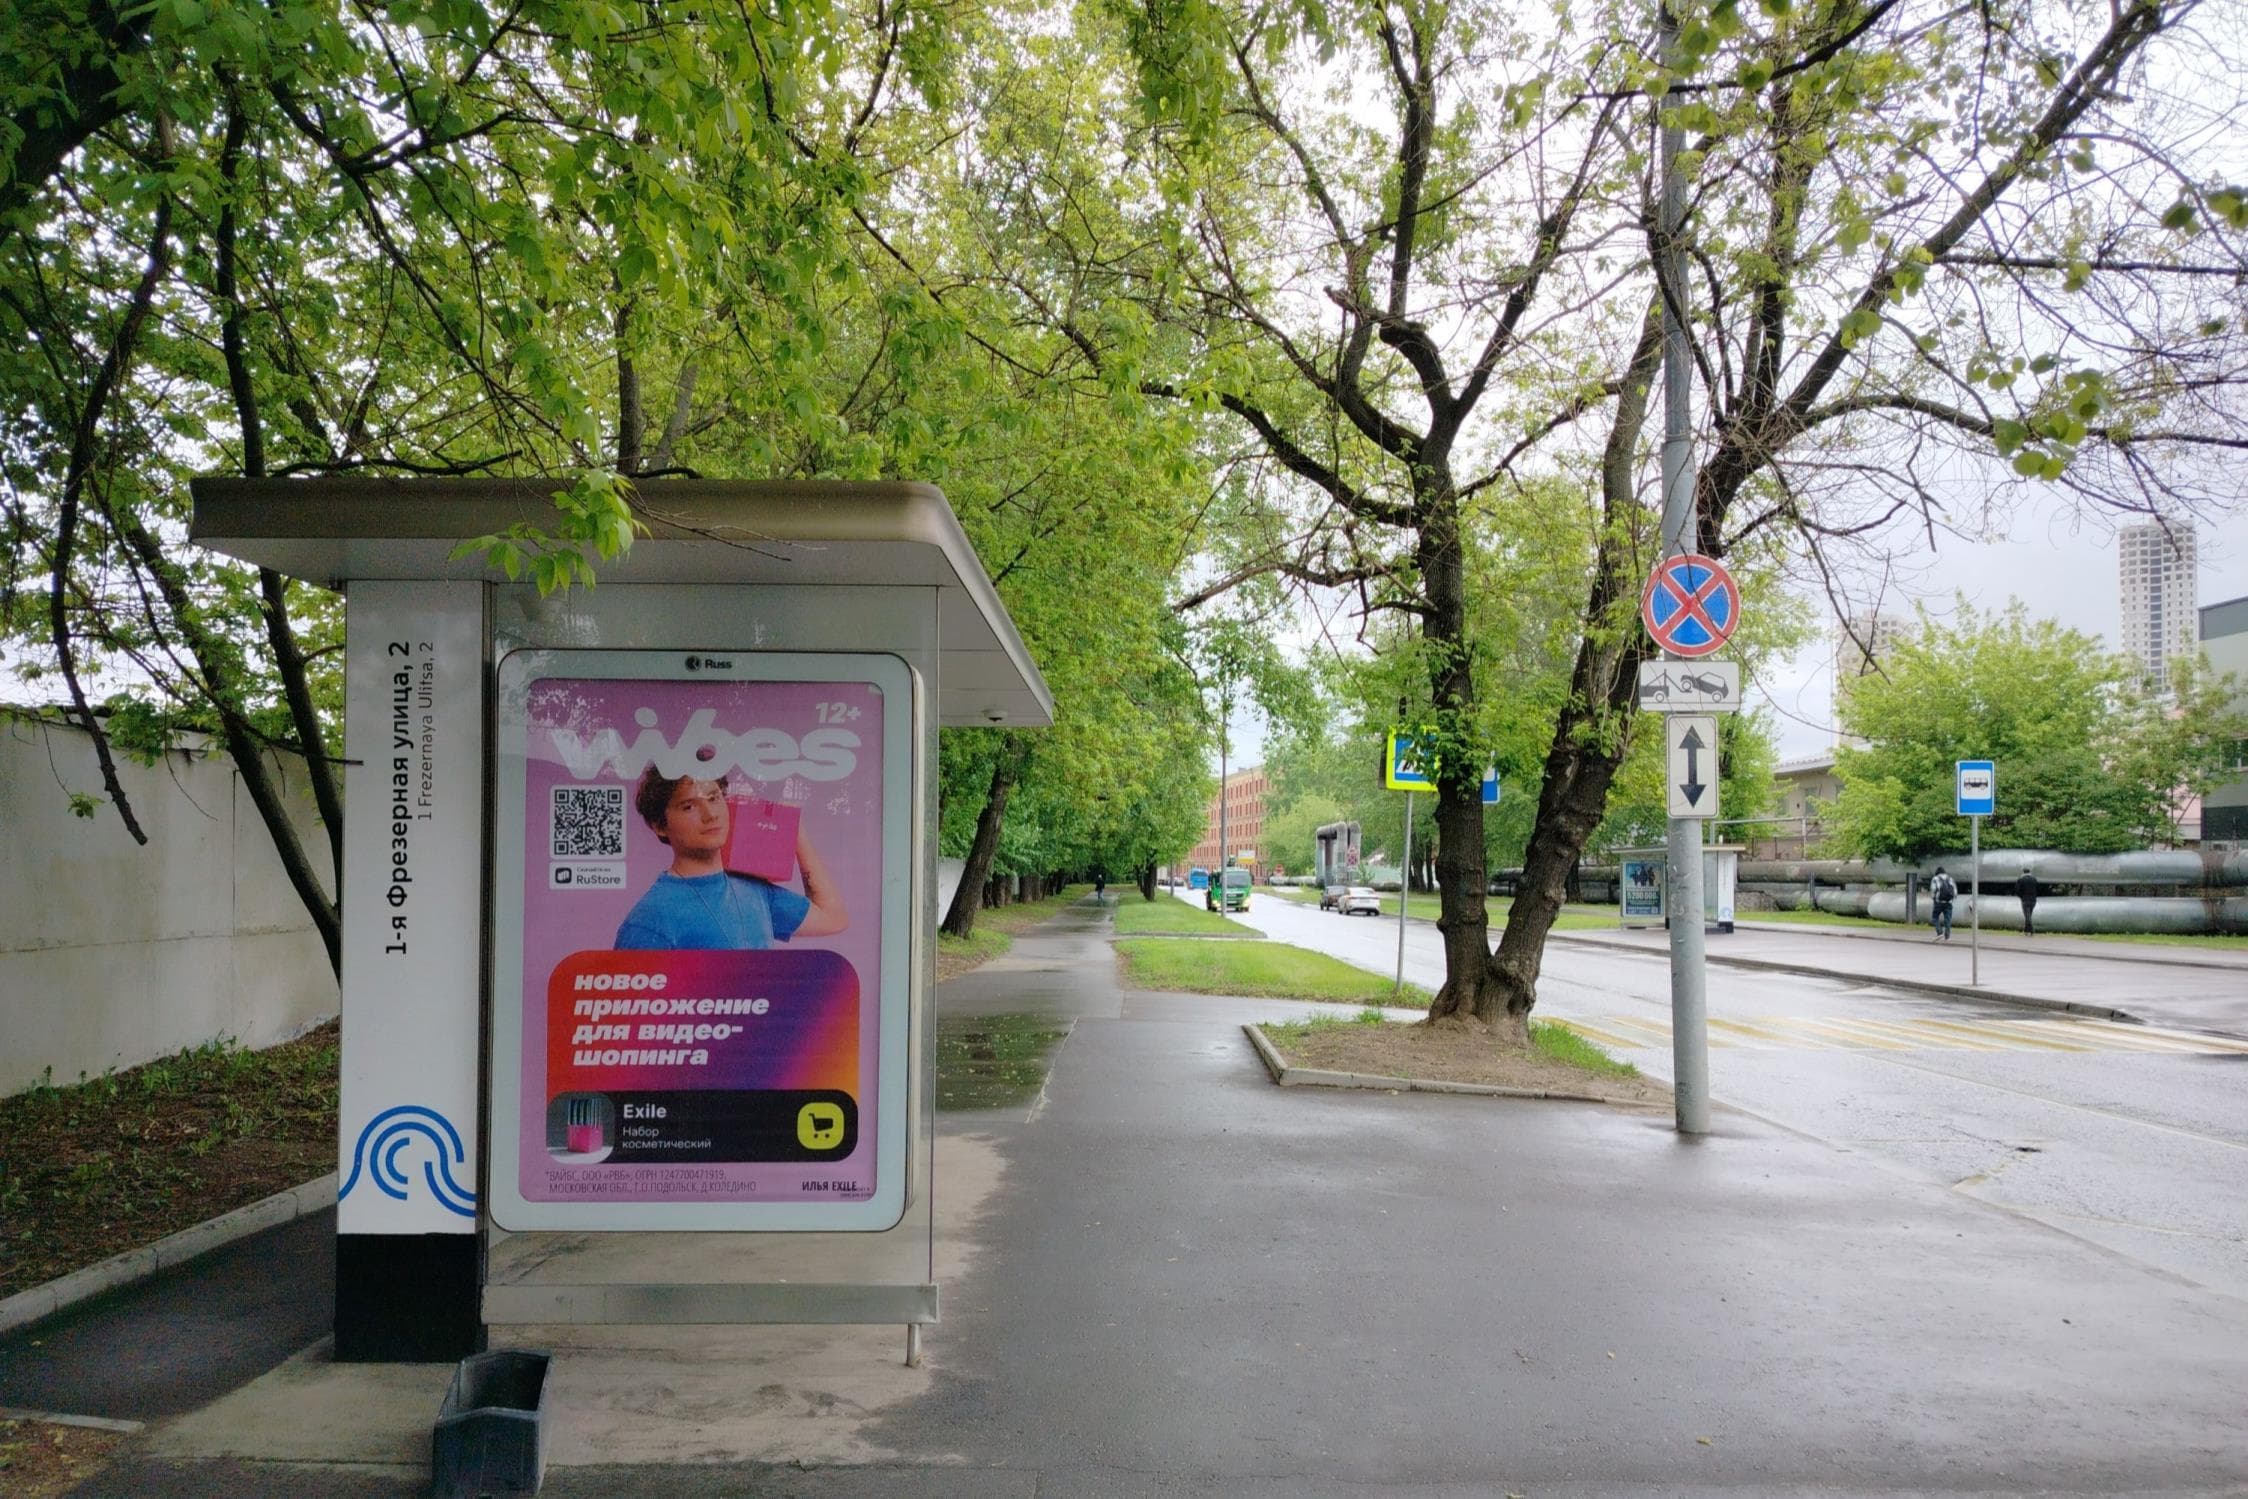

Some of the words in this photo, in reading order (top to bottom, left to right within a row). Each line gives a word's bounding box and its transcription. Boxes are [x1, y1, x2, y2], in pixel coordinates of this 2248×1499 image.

[388, 641, 410, 657] 2
[419, 642, 434, 652] 2
[705, 659, 732, 669] Russ
[418, 658, 435, 708] Ulitsa,
[392, 665, 414, 749] улица,
[815, 702, 862, 724] 12+
[418, 715, 436, 806] Frezernaya
[418, 811, 432, 820] 1
[386, 757, 413, 907] Фрезерная
[576, 875, 621, 885] RuStore
[386, 916, 407, 954] 1-я
[574, 974, 668, 990] новое
[574, 998, 770, 1022] приложение
[572, 1024, 631, 1045] для
[638, 1023, 744, 1044] видео-
[573, 1049, 709, 1066] шопинга
[623, 1103, 667, 1118] Exile
[622, 1126, 660, 1138] Набор
[622, 1138, 712, 1149] косметический
[549, 1182, 607, 1193] МОСКОВСКАЯ
[802, 1181, 829, 1191] ИЛЬЯ
[832, 1181, 857, 1191] EXILE
